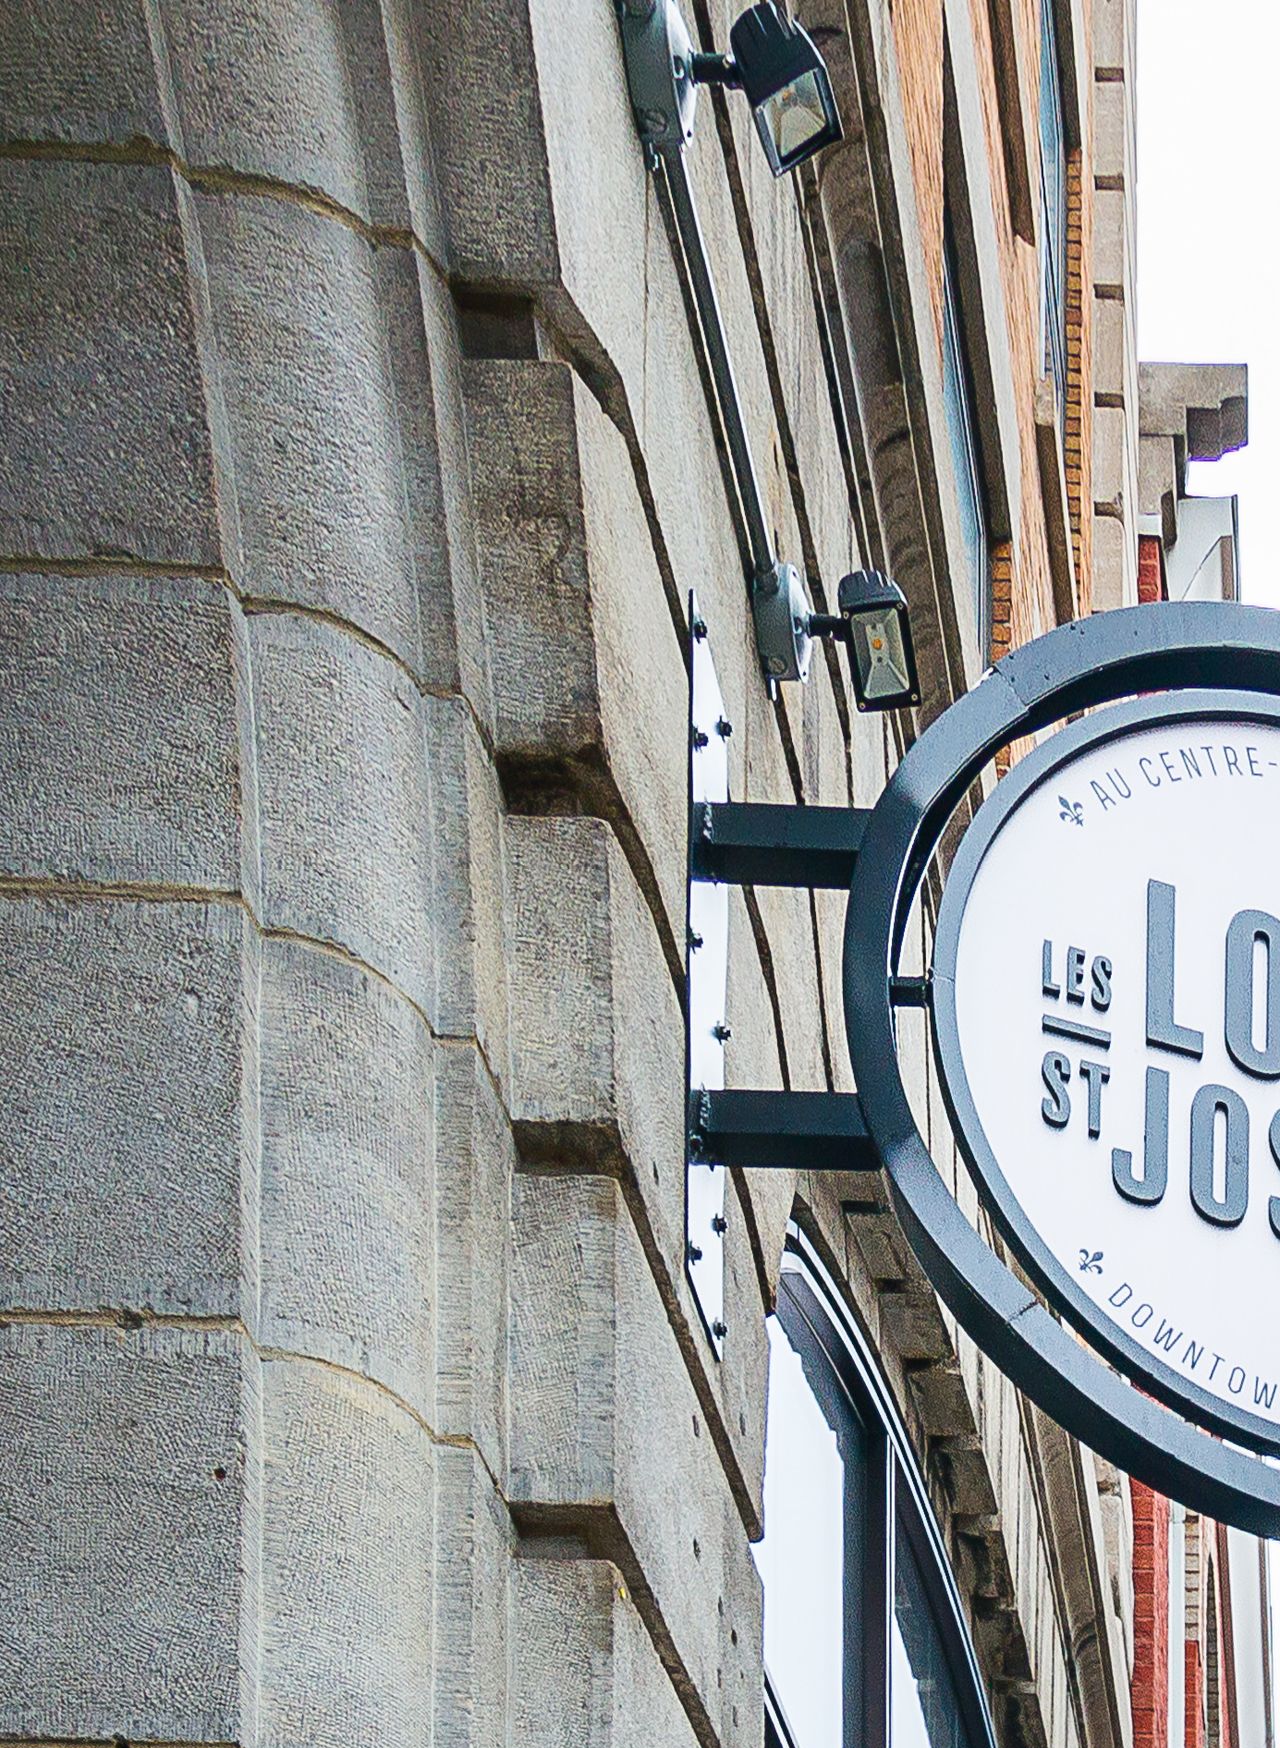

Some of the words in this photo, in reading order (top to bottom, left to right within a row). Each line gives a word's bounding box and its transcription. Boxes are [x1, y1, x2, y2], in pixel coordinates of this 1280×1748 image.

[1090, 768, 1131, 811] AU
[1042, 938, 1112, 1012] LES
[1041, 1050, 1111, 1140] ST
